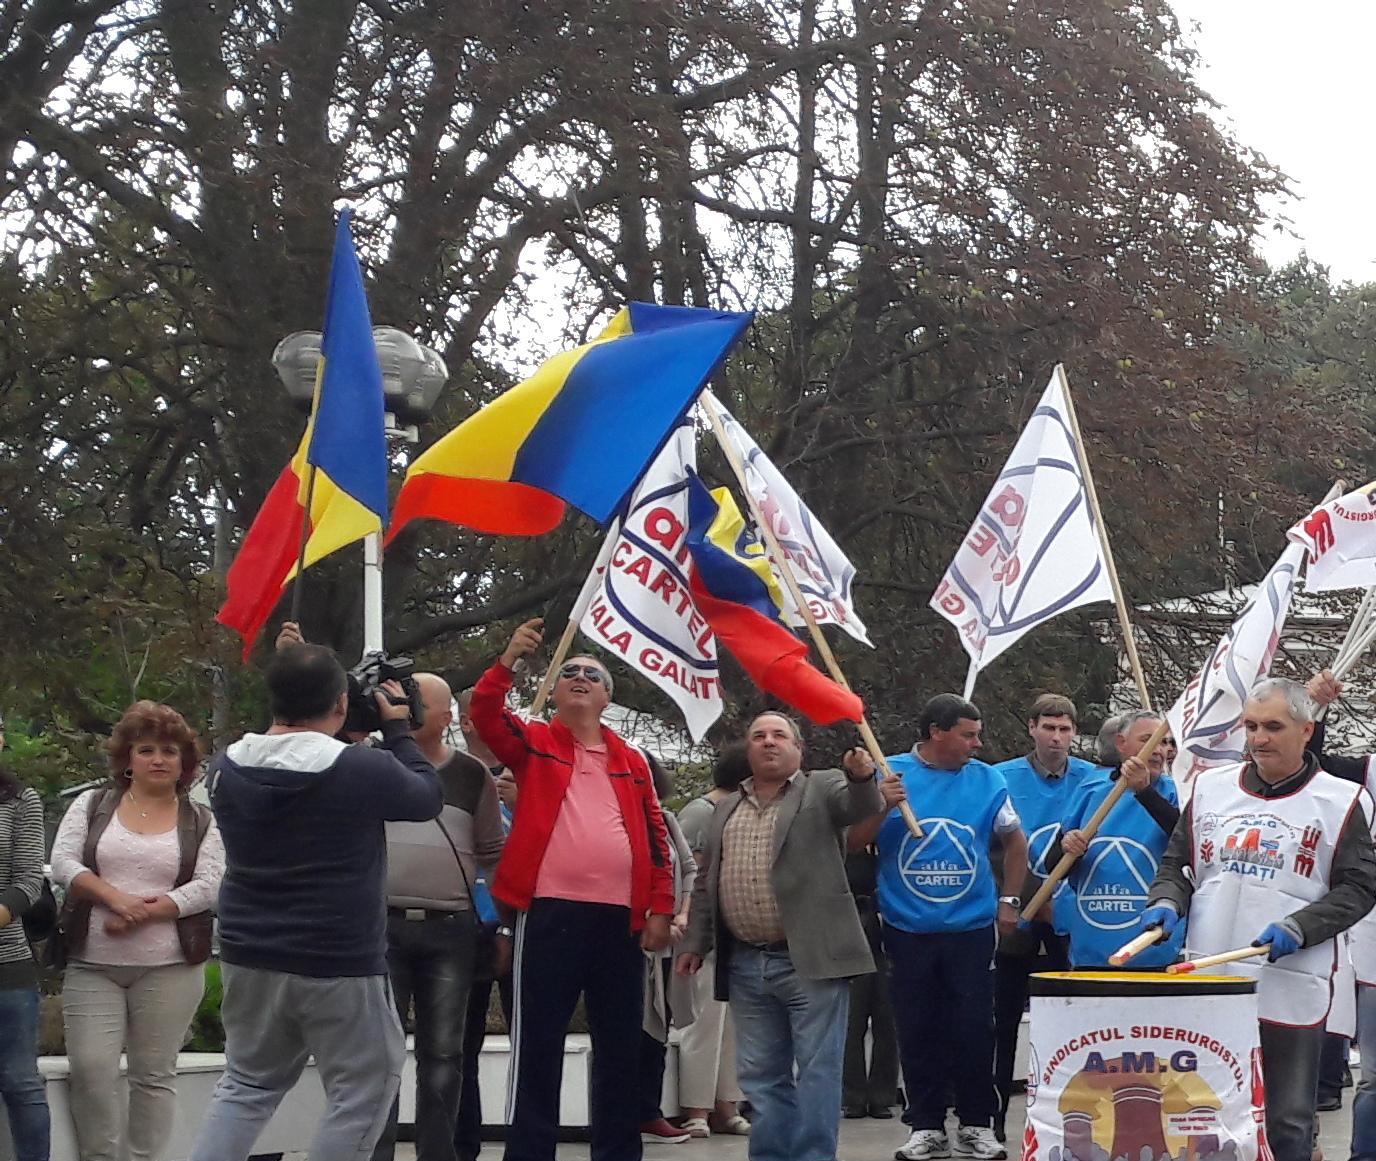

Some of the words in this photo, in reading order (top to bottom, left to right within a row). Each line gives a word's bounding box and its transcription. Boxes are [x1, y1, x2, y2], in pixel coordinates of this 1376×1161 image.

[612, 541, 714, 660] CARTEL
[915, 875, 963, 886] CARTEL
[1088, 900, 1137, 912] CARTEL
[1043, 1027, 1124, 1086] SINDICATUL
[1130, 1025, 1248, 1092] SIDERURGISTUL
[1083, 1050, 1198, 1073] A.M.G
